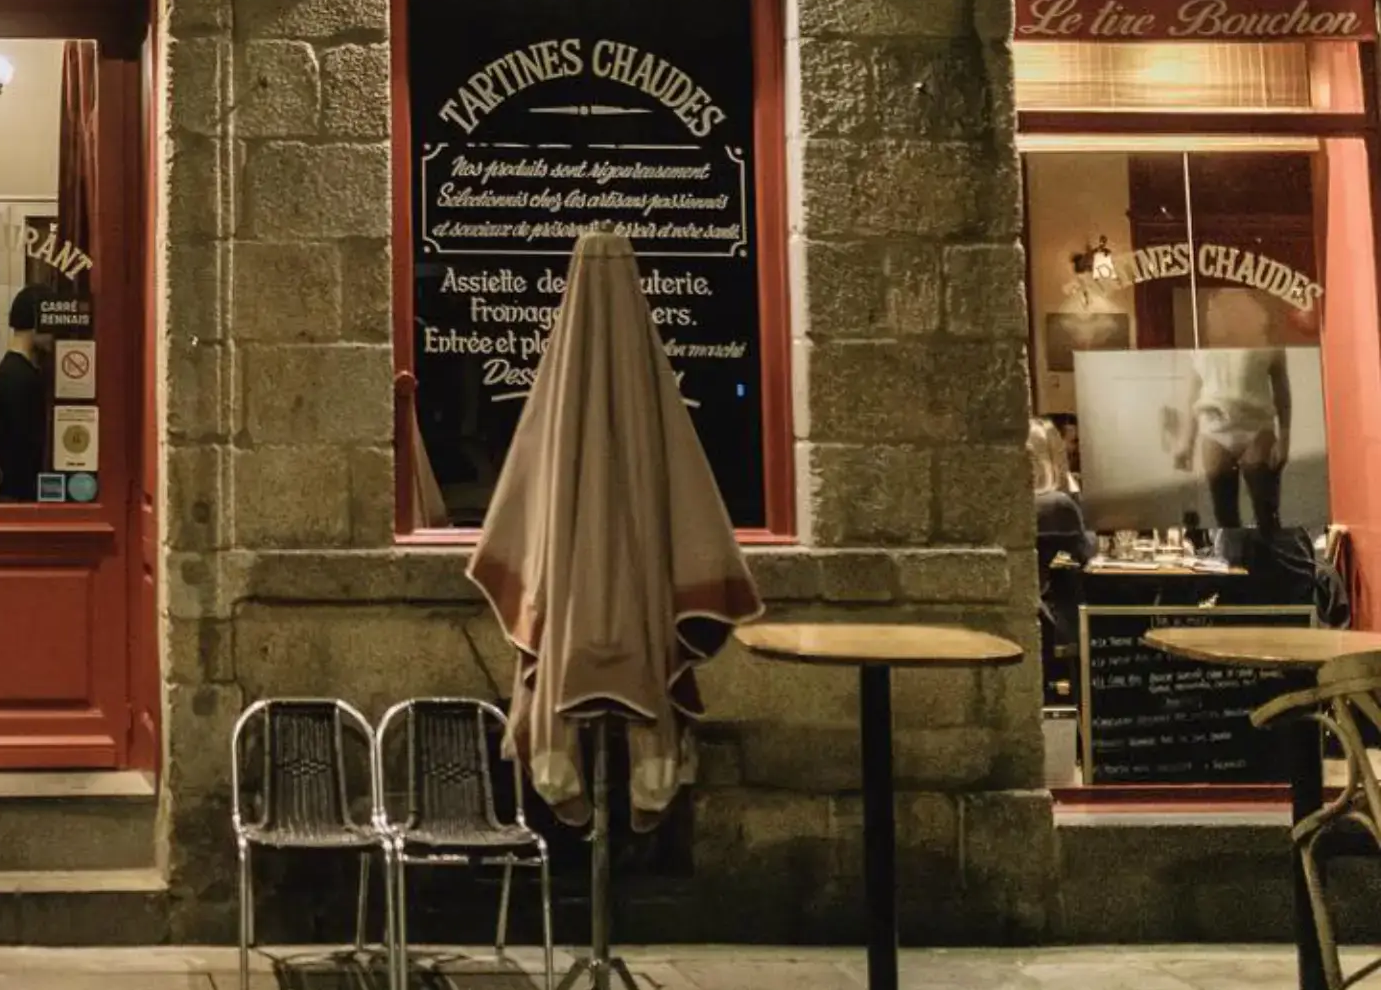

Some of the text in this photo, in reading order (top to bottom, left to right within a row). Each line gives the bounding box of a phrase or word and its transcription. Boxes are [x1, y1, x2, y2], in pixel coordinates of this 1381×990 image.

[438, 38, 728, 138] TARTINES CHAUDES
[451, 154, 484, 178] Nos
[480, 159, 548, 185] produits
[549, 160, 588, 178] sont
[529, 187, 562, 213] chez
[439, 266, 528, 294] Assiette
[536, 268, 568, 294] de
[1198, 244, 1324, 312] CHAUDES
[40, 313, 91, 326] RENNAIS
[424, 326, 494, 354] Entrée
[495, 330, 517, 354] et
